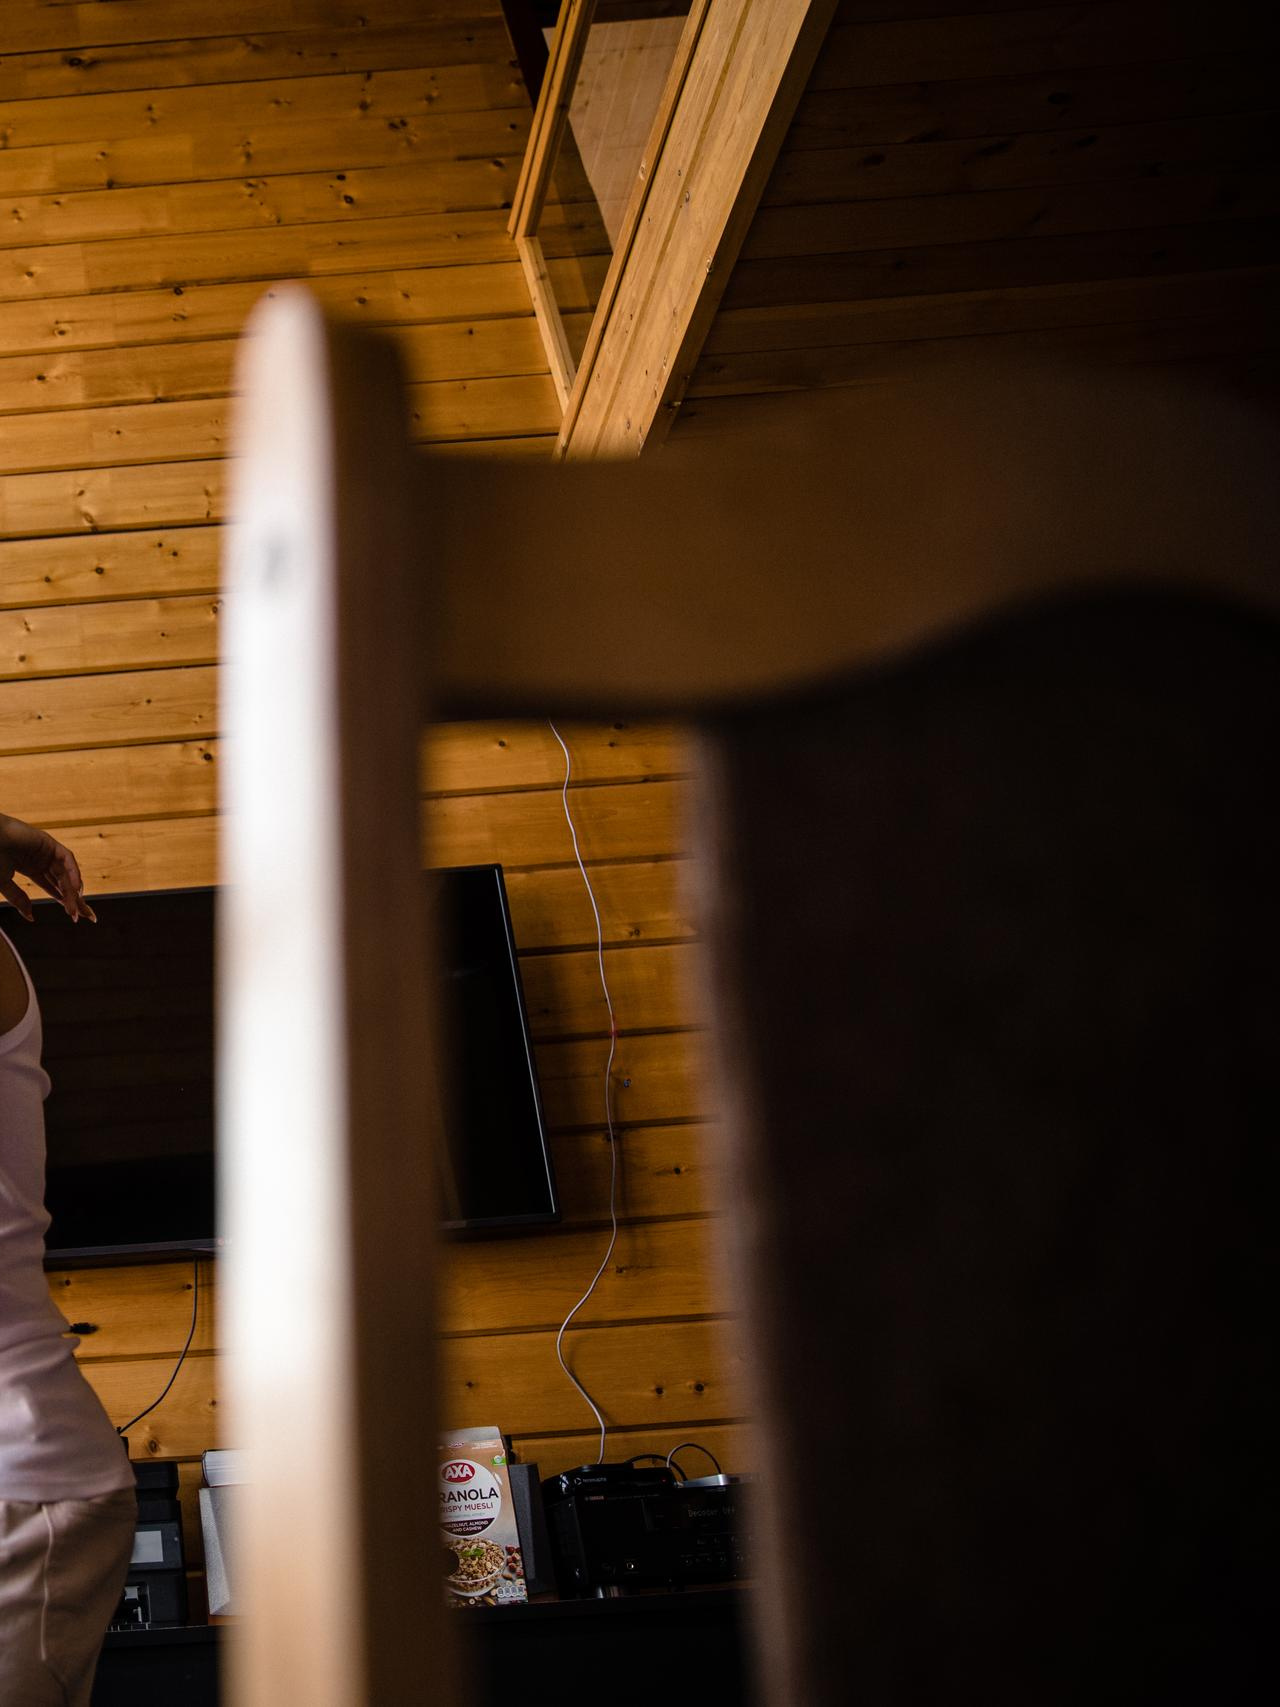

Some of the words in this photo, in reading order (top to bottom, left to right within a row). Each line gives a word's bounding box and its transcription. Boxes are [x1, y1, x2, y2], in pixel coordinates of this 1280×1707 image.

[445, 1464, 473, 1479] AXA
[439, 1487, 499, 1504] RANOLA
[440, 1504, 462, 1513] RISPY
[464, 1502, 493, 1512] MUESLI
